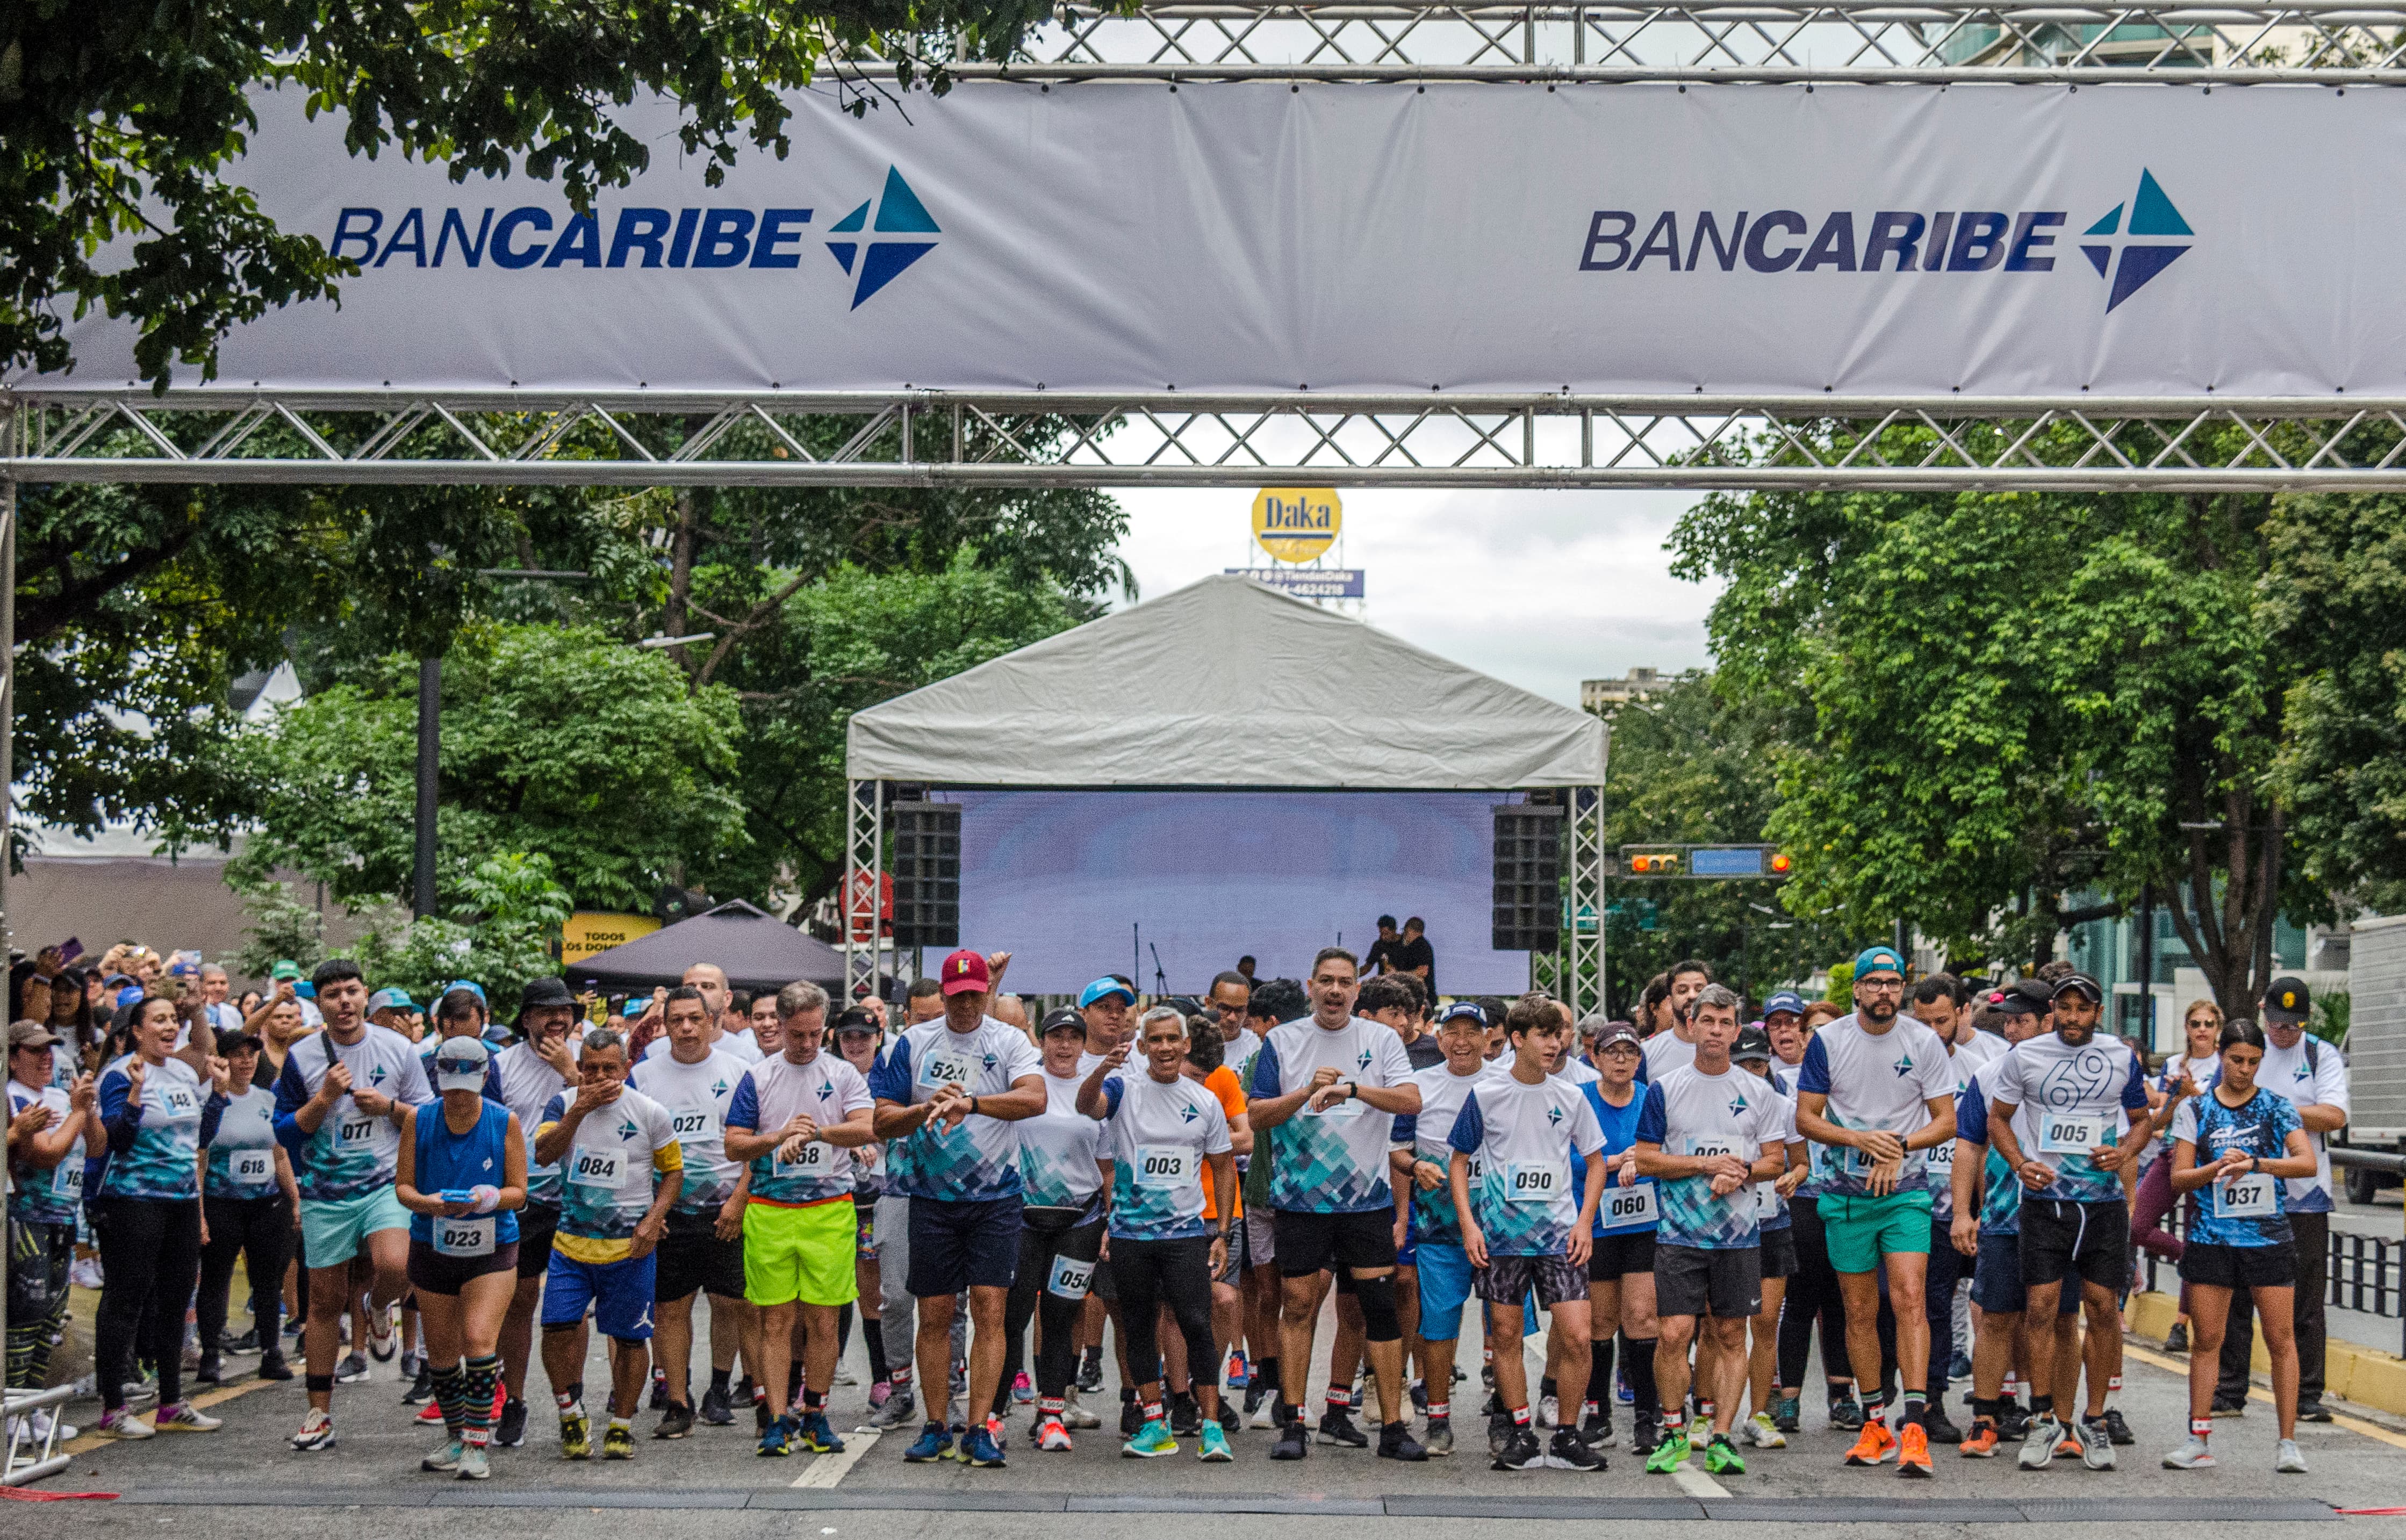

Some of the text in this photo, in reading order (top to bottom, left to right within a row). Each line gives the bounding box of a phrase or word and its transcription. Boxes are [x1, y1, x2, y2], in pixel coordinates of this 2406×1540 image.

[328, 207, 814, 269] BANCARIBE
[1578, 210, 2068, 274] BANCARIBE
[1266, 496, 1330, 528] Daka
[585, 932, 626, 941] TODOS
[2040, 1048, 2113, 1114] 69
[342, 1120, 373, 1140] 077
[673, 1115, 706, 1133] 027
[2050, 1124, 2088, 1142] 005
[240, 1160, 265, 1174] 618
[579, 1156, 616, 1177] 084
[1145, 1157, 1181, 1175] 003
[1516, 1172, 1552, 1189] 090
[2225, 1186, 2261, 1205] 037
[1612, 1195, 1646, 1216] 060
[444, 1229, 482, 1247] 023
[1059, 1270, 1092, 1289] 054
